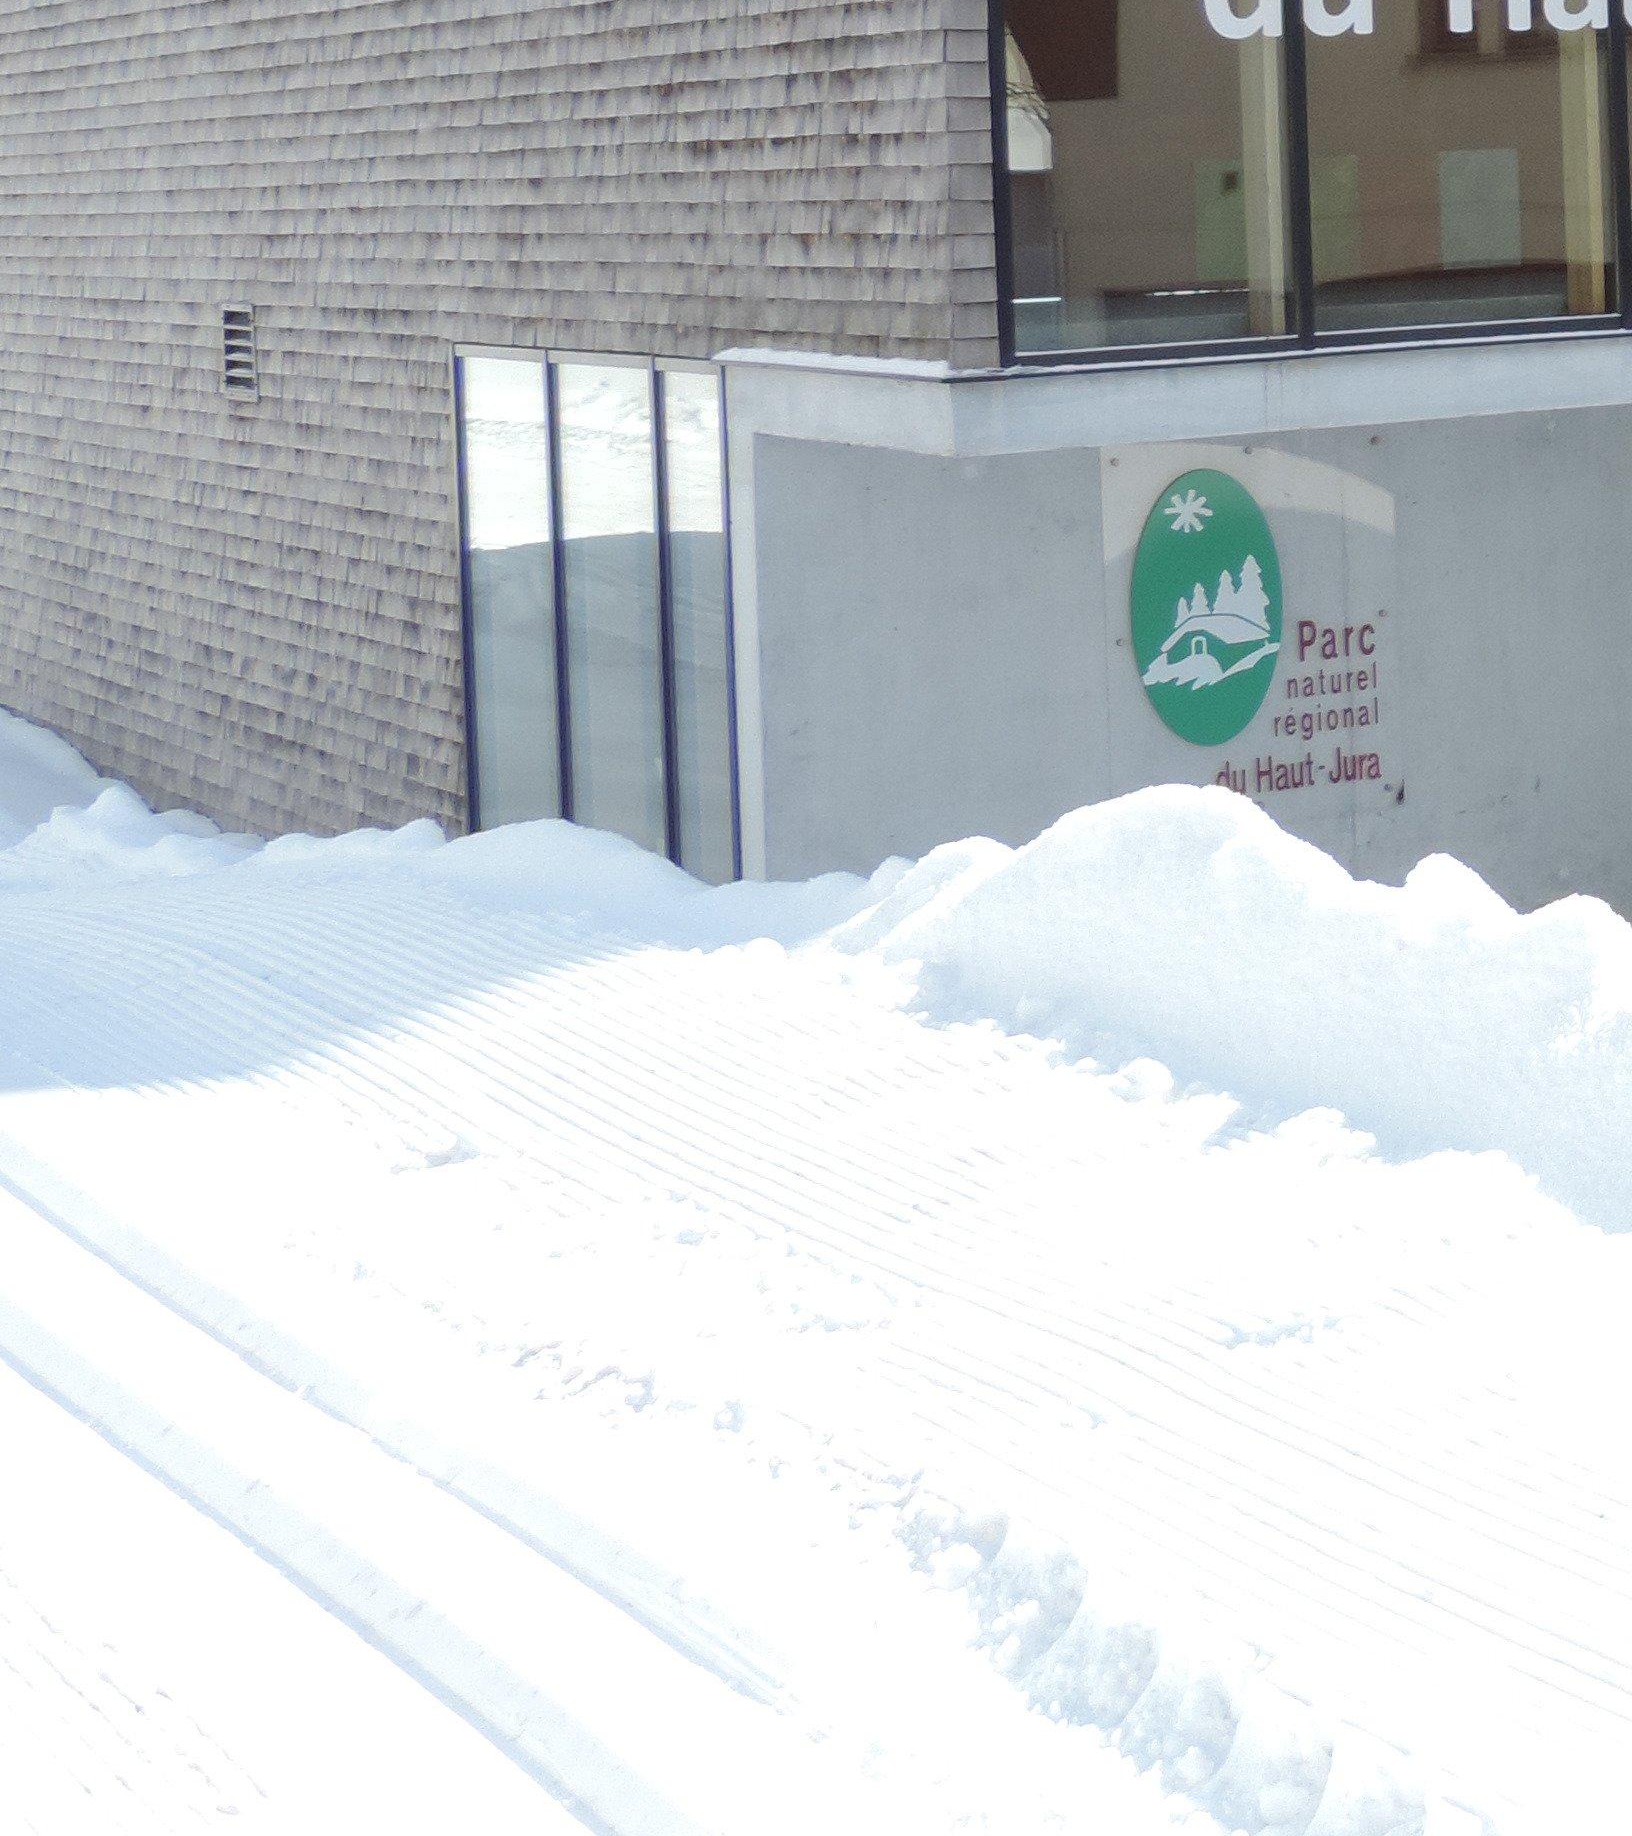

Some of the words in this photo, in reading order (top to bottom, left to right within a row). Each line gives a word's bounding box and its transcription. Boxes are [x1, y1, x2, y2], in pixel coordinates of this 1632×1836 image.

[1298, 620, 1375, 661] Parc
[1287, 661, 1377, 698] naturel
[1274, 696, 1379, 740] régional
[1216, 760, 1246, 795] du
[1256, 746, 1382, 793] Haut-Jura
